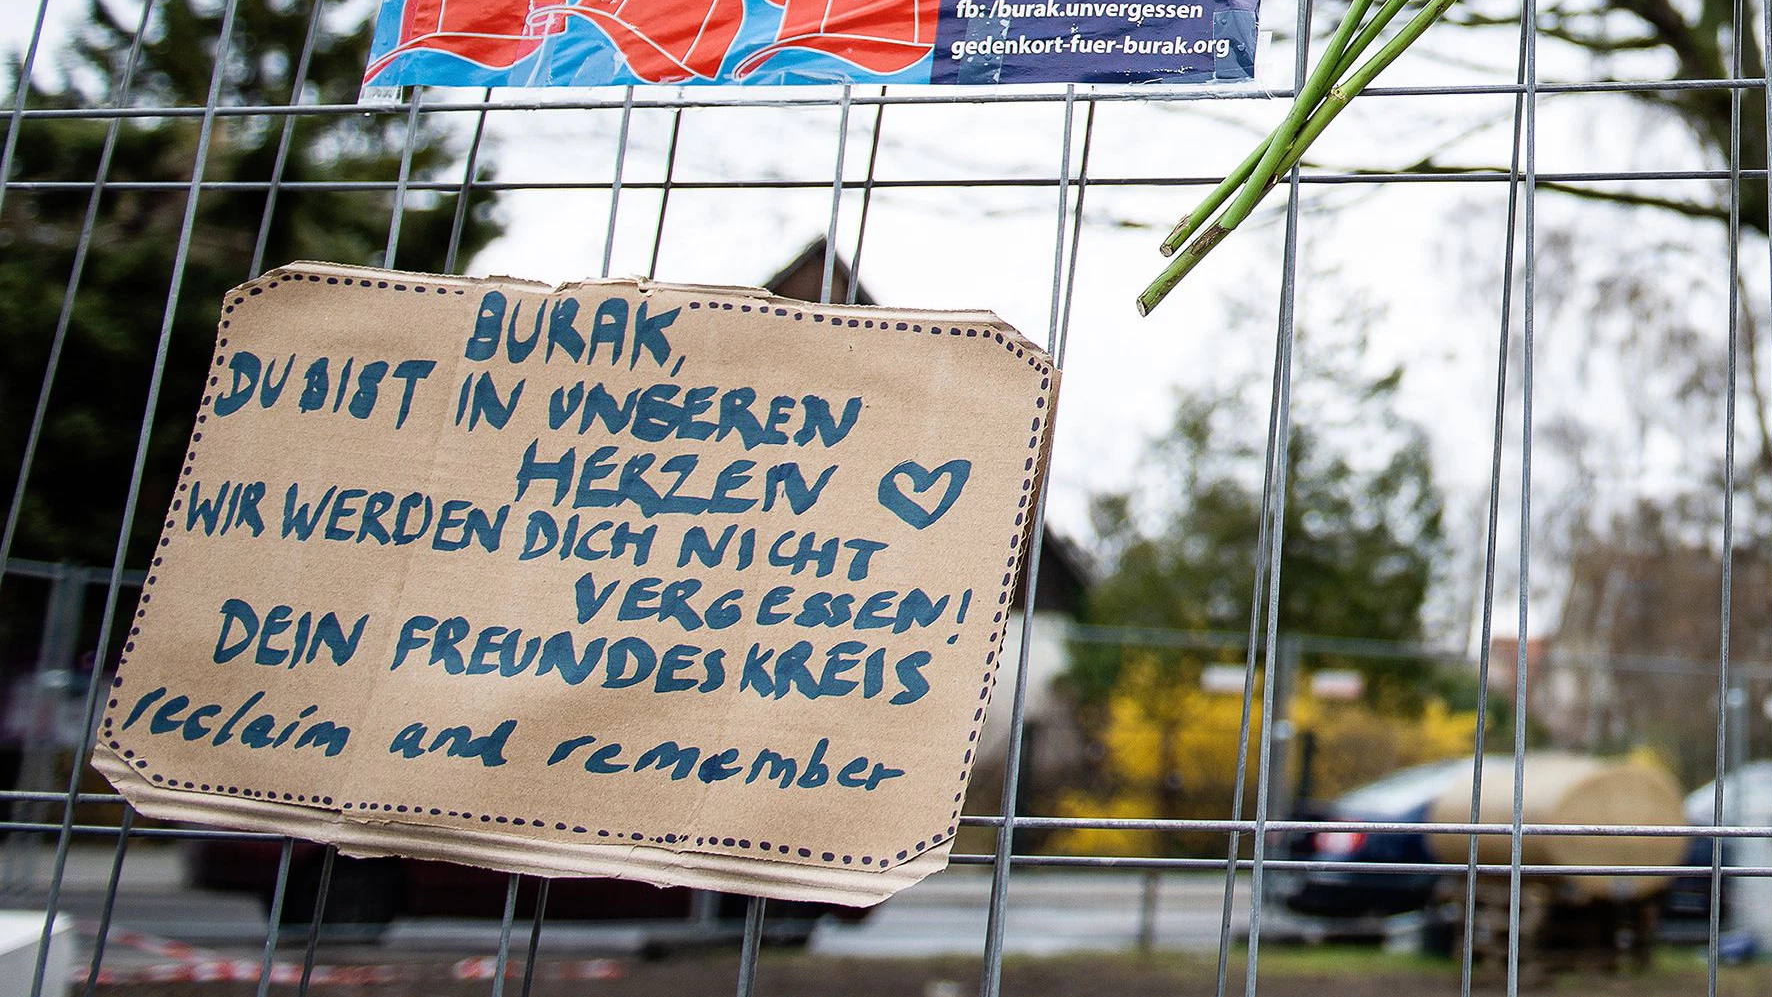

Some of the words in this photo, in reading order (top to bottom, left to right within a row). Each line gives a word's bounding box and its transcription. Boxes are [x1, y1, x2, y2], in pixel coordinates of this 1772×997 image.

[951, 34, 1230, 60] gedenkort-fuer-burak.org
[464, 290, 686, 377] BURAK,
[213, 350, 296, 417] DU
[299, 356, 436, 430] BIST
[455, 371, 526, 431] IN
[548, 380, 863, 451] UNSEREN
[514, 437, 839, 518] HERZEN
[182, 480, 266, 539] WIR
[281, 482, 511, 553] WERDEN
[519, 510, 658, 567] DICH
[677, 524, 889, 581] NICHT
[212, 598, 370, 670] DEIN
[574, 572, 973, 645] VERGESSEN!
[122, 687, 350, 757] reclaim
[390, 720, 517, 767] and
[547, 736, 905, 790] remember
